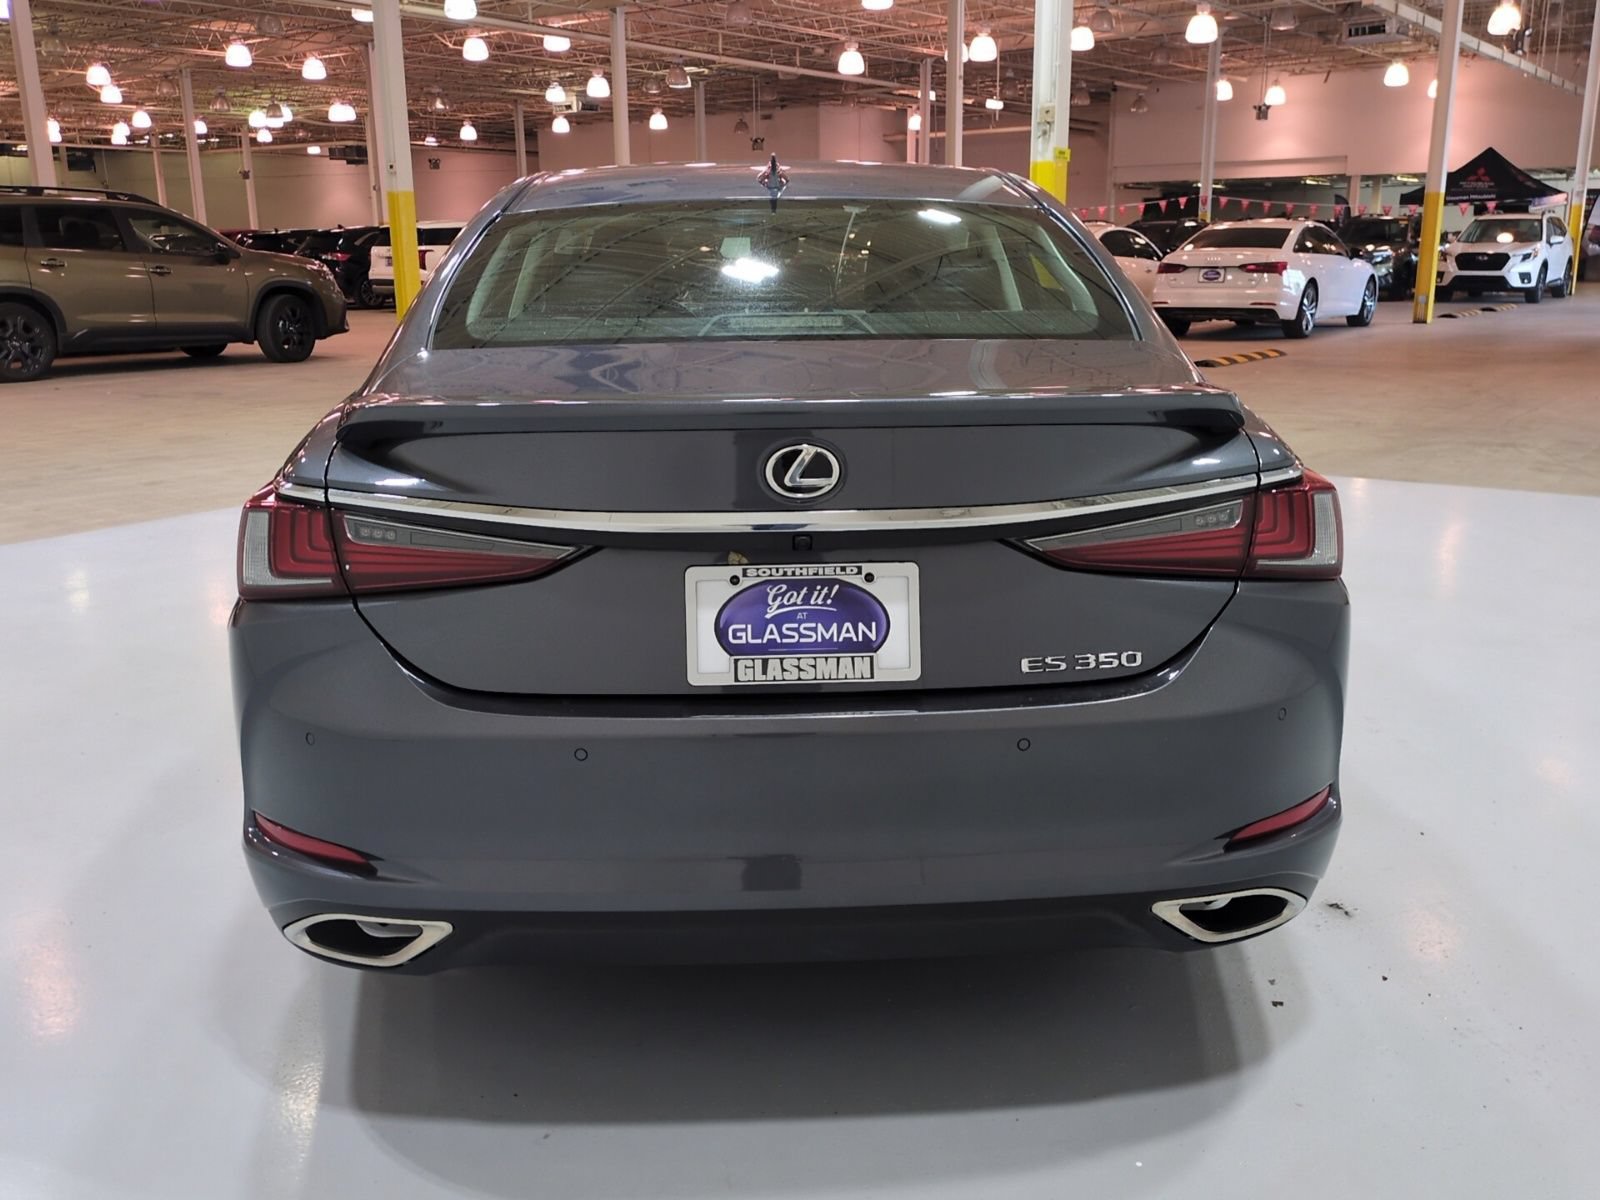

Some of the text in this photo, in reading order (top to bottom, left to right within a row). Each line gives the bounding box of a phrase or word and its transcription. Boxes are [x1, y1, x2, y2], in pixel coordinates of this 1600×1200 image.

[746, 566, 858, 577] SOUTHFIELD
[767, 584, 839, 613] Got it!
[797, 612, 808, 620] AT
[728, 622, 877, 644] GLASSMAN
[737, 657, 871, 682] GLASSMAN
[1021, 651, 1142, 673] ES 350
